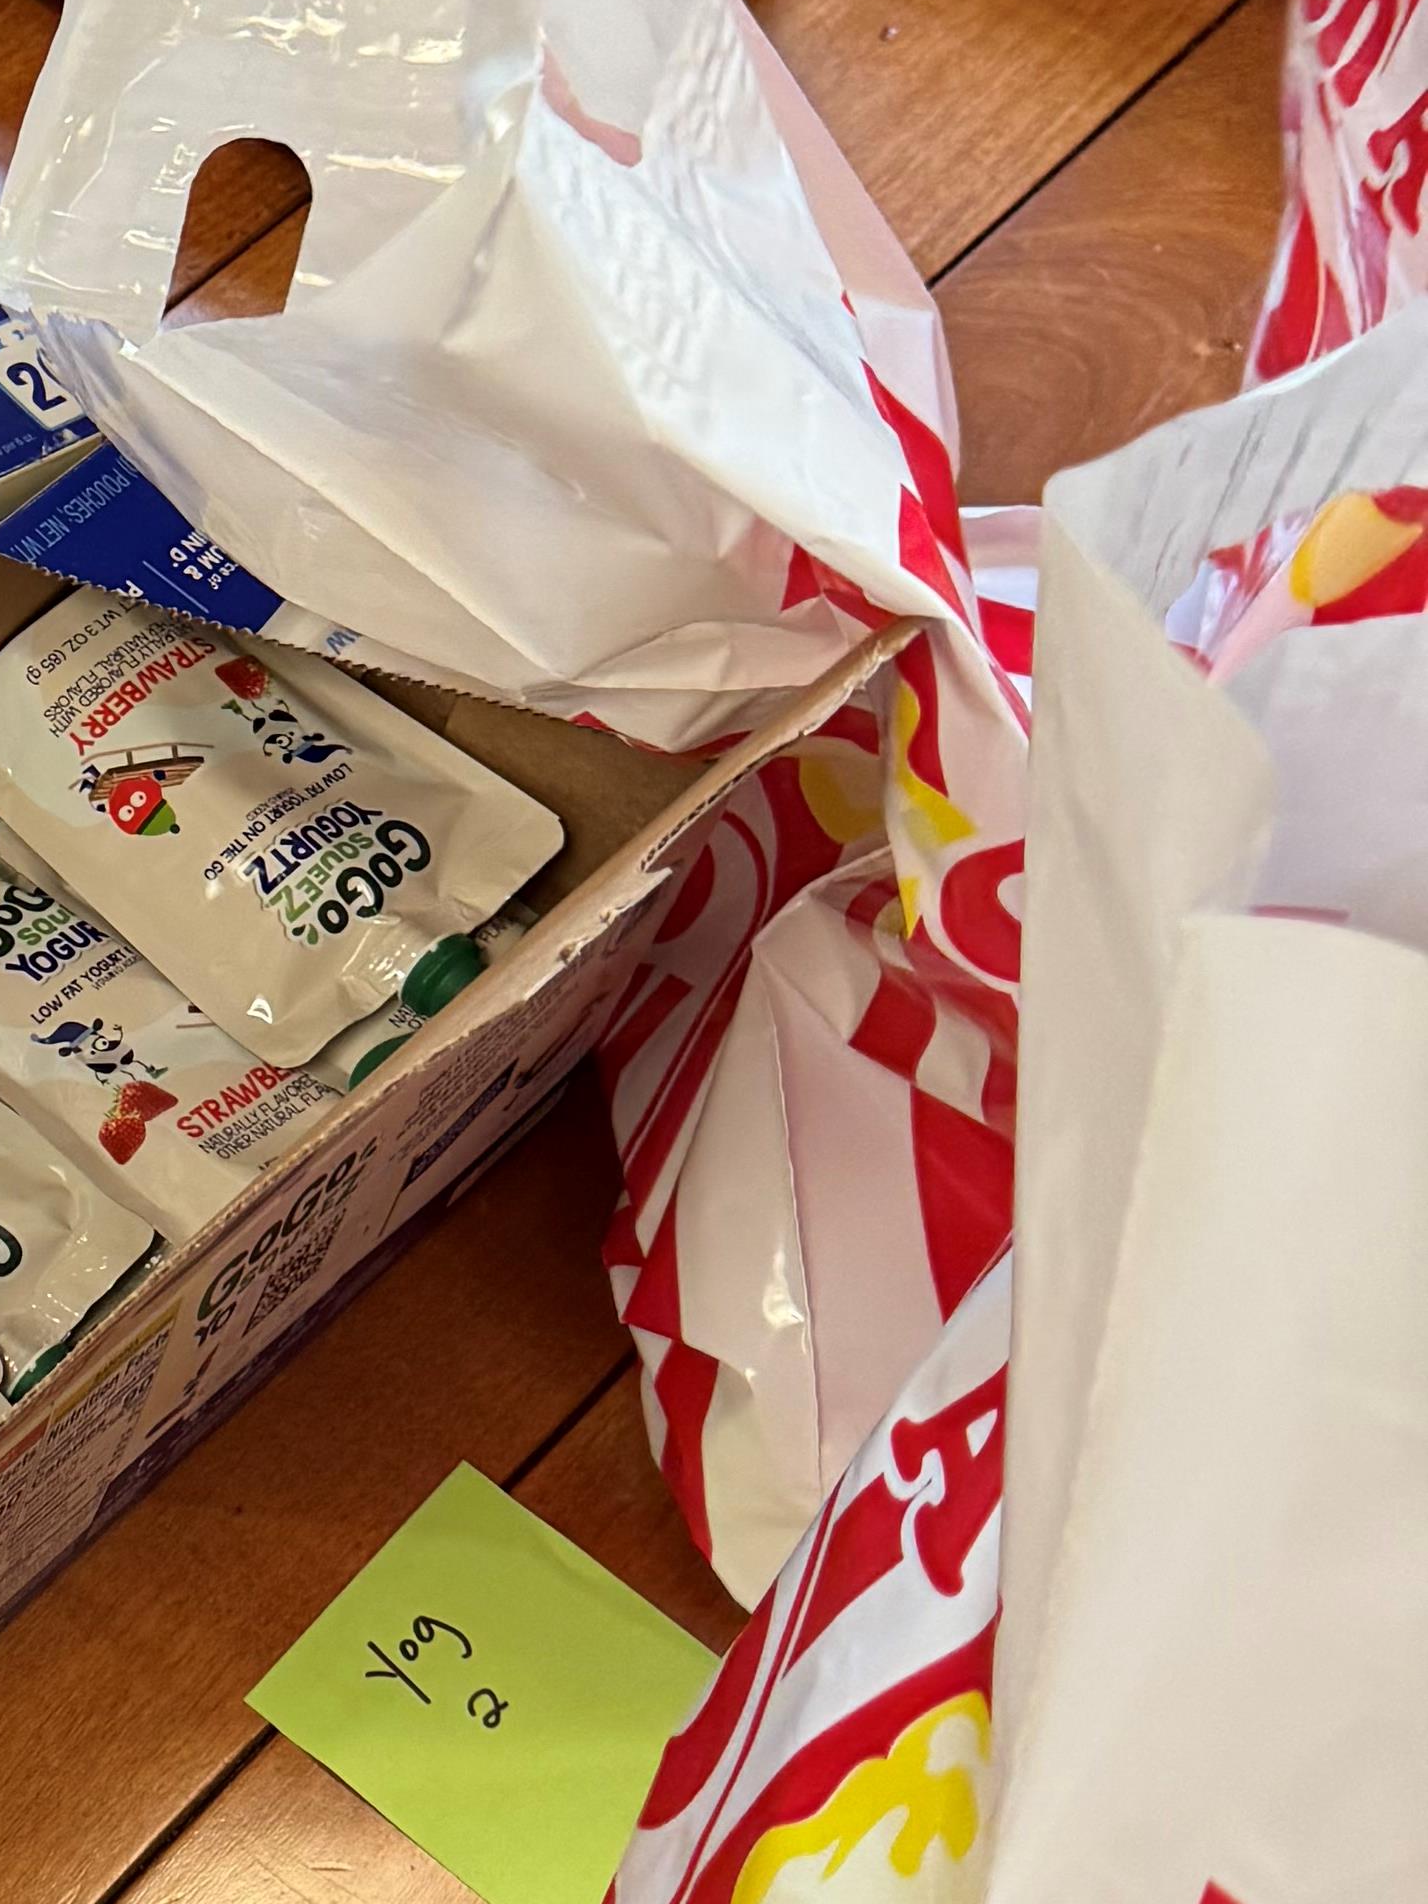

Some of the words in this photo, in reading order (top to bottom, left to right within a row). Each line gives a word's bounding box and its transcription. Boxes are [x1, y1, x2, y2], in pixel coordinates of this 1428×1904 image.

[41, 648, 69, 676] (85
[67, 632, 90, 654] OZ
[26, 662, 43, 687] g)
[68, 636, 217, 756] STRAWBERRY
[323, 761, 354, 787] LOW
[263, 793, 307, 828] YOGURT
[242, 819, 267, 844] ON
[244, 799, 384, 896] YOGURTZ
[202, 860, 226, 881] GO
[219, 839, 250, 866] THE
[269, 830, 375, 925] SQUEEZ
[314, 816, 432, 936] GoGo
[28, 993, 66, 1026] LOW
[58, 972, 89, 1004] FAT
[196, 1107, 265, 1157] NATURALLY
[213, 1130, 254, 1161] OTHER
[247, 1101, 306, 1141] NATURAL
[467, 1687, 509, 1729] 2
